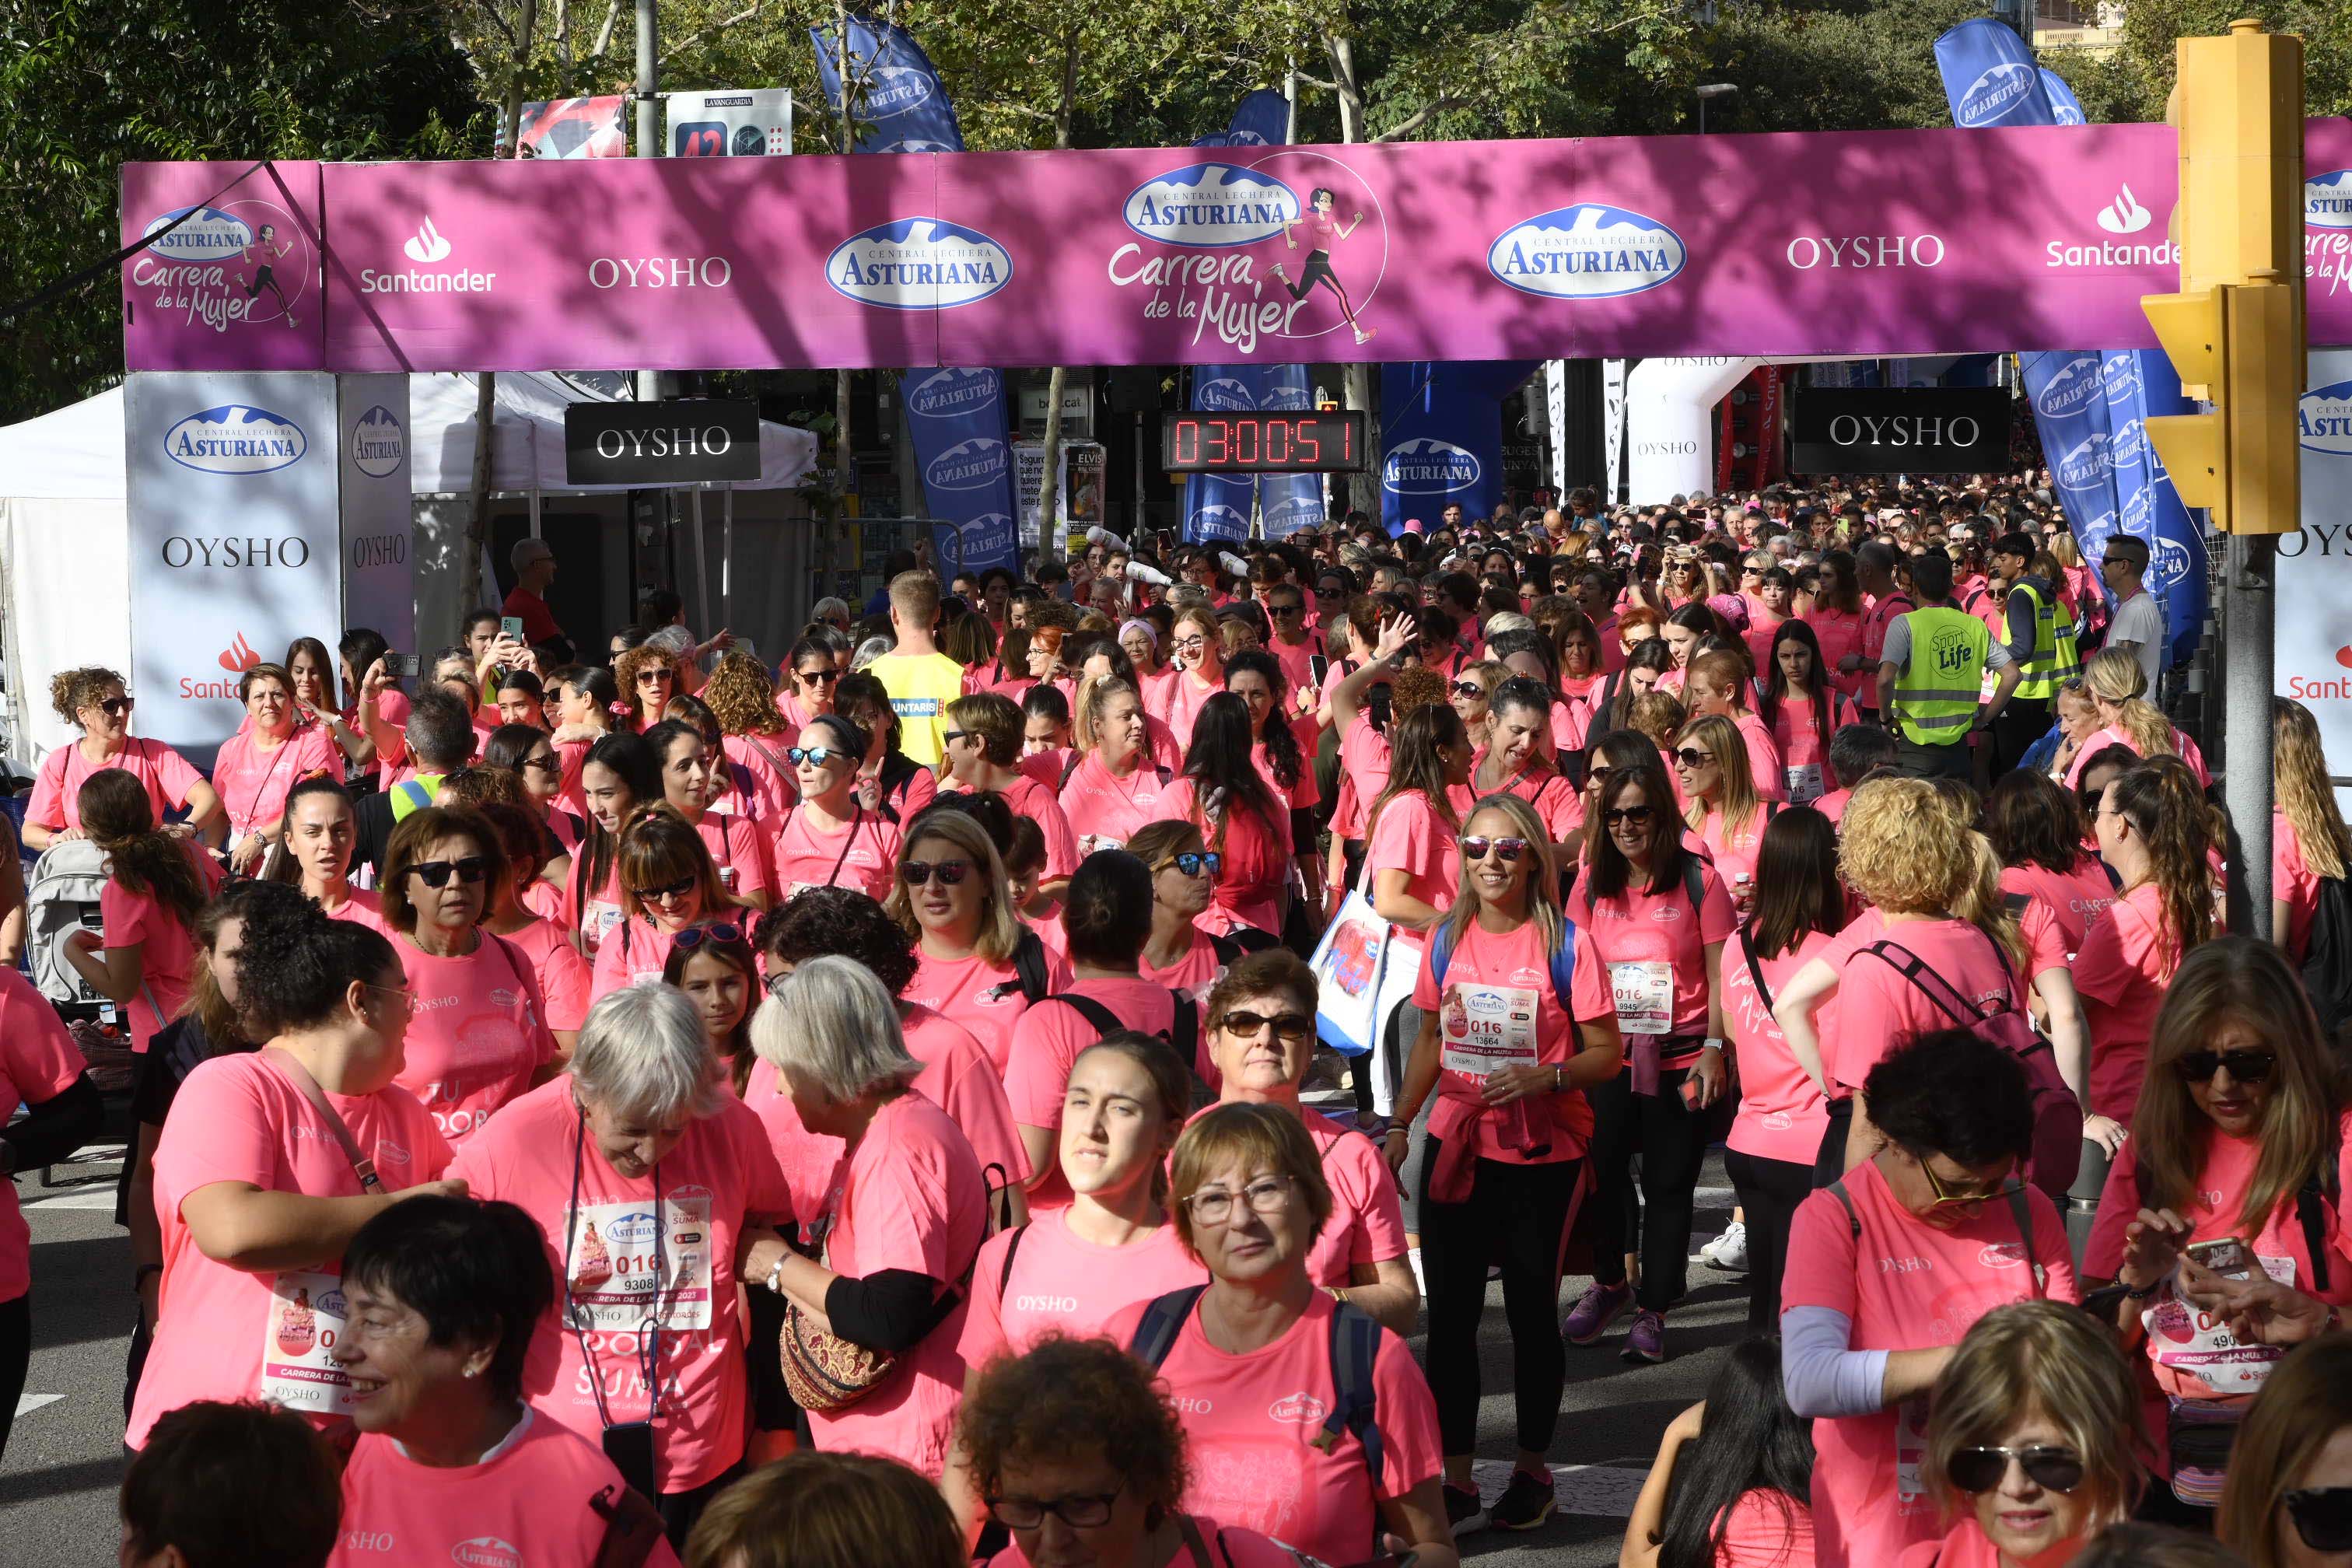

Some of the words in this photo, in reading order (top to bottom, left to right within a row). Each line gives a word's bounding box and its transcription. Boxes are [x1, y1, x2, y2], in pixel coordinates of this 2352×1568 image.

[1163, 192, 1220, 201] CENTRAL
[1225, 191, 1282, 200] LECHERA
[1136, 195, 1286, 226] ASTURIANA
[1534, 236, 1594, 247] CENTRAL
[1600, 235, 1664, 246] LECHERA
[1787, 234, 1945, 269] OYSHO
[868, 249, 928, 258] CENTRAL
[1108, 243, 1255, 286] Carrera
[1503, 240, 1671, 275] ASTURIANA
[2046, 240, 2182, 268] Santande
[133, 257, 224, 286] Carrera
[361, 268, 496, 293] Santander
[589, 257, 732, 289] OYSHO
[840, 253, 998, 287] ASTURIANA
[156, 289, 173, 309] de
[176, 286, 188, 309] la
[187, 285, 260, 333] Mujer
[1144, 289, 1171, 319] de
[1177, 287, 1196, 319] la
[1192, 282, 1308, 354] Mujer
[247, 428, 292, 436] LECHERA
[597, 425, 731, 458] OYSHO
[1176, 420, 1349, 463] 03:00:51
[1829, 415, 1980, 447] OYSHO
[176, 430, 297, 457] ASTURIANA
[355, 432, 402, 460] ASTURIANA
[1638, 441, 1697, 457] OYSHO
[1078, 453, 1102, 464] ELVIS
[1385, 460, 1473, 482] ASTURIANA
[161, 536, 310, 568] OYSHO
[353, 533, 405, 569] OYSHO
[1932, 629, 1965, 652] Sport
[1939, 643, 1972, 670] Life
[2289, 676, 2352, 700] Sant
[894, 702, 936, 713] UNTARIS
[1470, 1020, 1503, 1034] 016
[1766, 1029, 1783, 1040] 2017
[1475, 1036, 1500, 1046] 13664
[672, 1216, 699, 1225] SUMA
[616, 1254, 663, 1275] 016
[1876, 1256, 1933, 1275] OYSHO
[624, 1278, 654, 1291] 9308
[582, 1293, 621, 1304] CARRERA
[622, 1294, 635, 1303] DE
[677, 1291, 698, 1300] 2023
[1017, 1295, 1077, 1313] OYSHO
[2212, 1335, 2236, 1349] 490
[280, 1367, 323, 1381] CARRERA
[323, 1373, 337, 1381] DE
[275, 1384, 320, 1402] OYSHO
